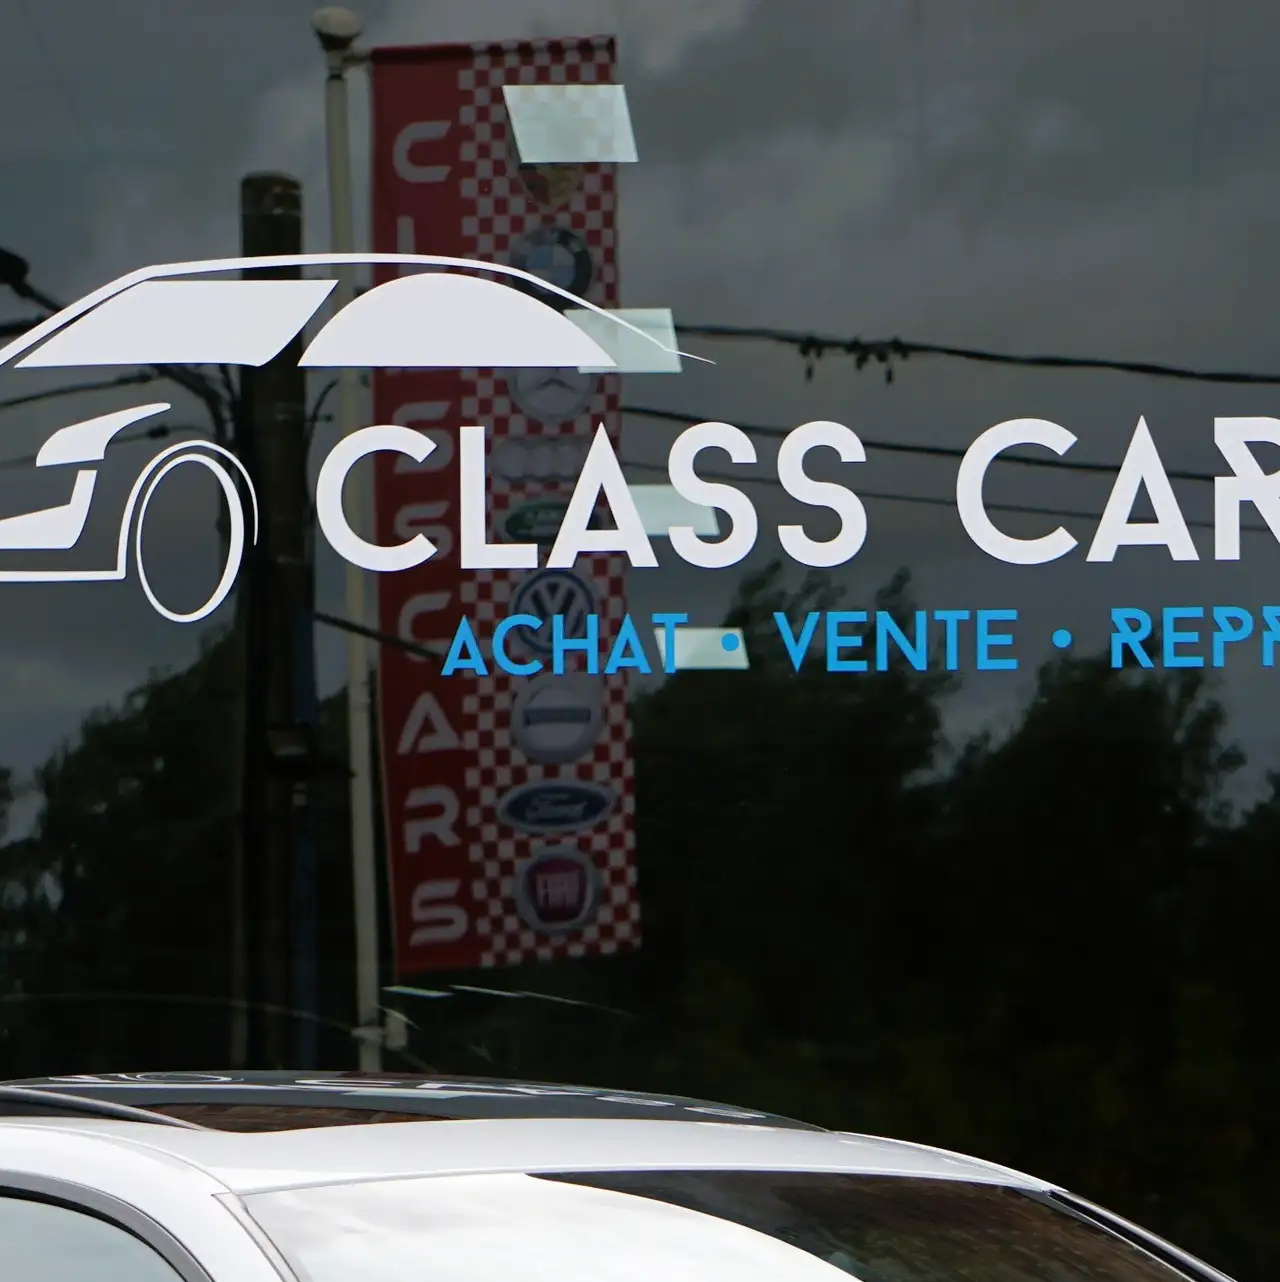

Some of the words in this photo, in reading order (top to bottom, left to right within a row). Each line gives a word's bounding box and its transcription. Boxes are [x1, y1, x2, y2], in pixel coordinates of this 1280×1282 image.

[316, 421, 868, 572] CLASS
[441, 612, 689, 676] ACHAT
[774, 608, 1019, 672] VENTE
